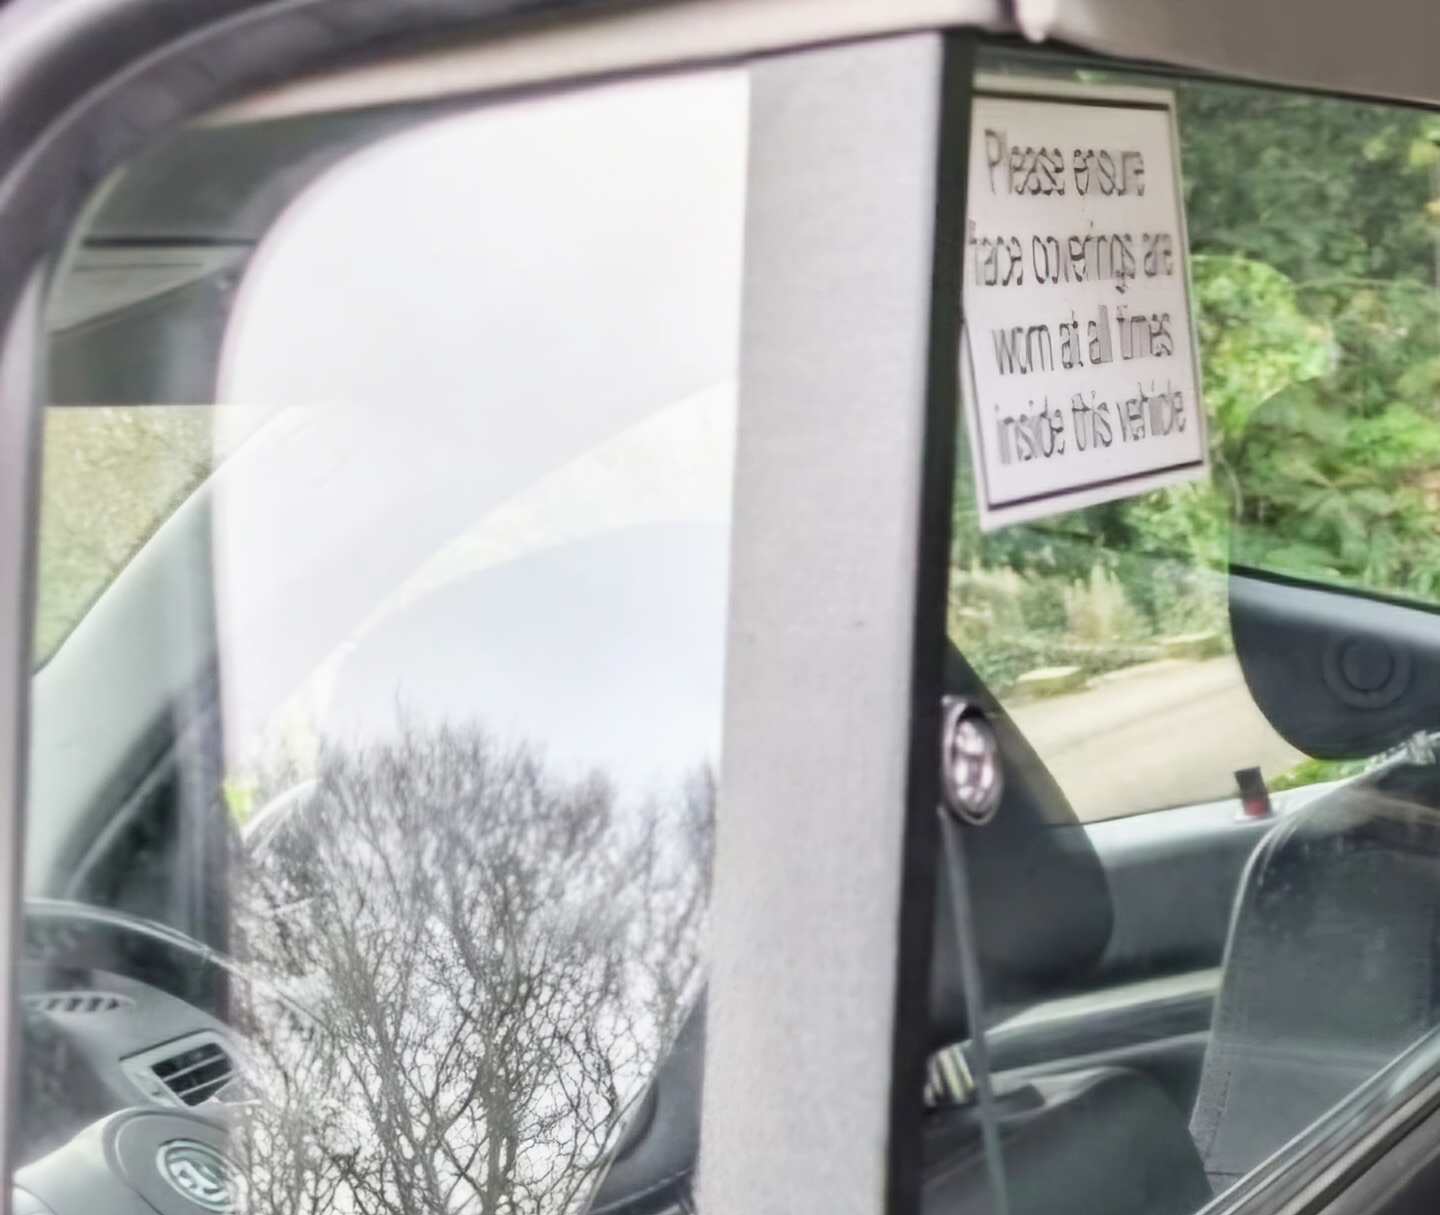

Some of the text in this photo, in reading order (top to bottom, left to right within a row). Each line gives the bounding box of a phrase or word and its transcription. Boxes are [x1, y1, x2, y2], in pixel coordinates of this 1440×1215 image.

[984, 128, 1145, 196] Please ensure
[1032, 219, 1136, 294] coverings
[1143, 233, 1173, 277] are
[991, 304, 1172, 375] worn at all times
[994, 379, 1186, 465] inside this vehicle
